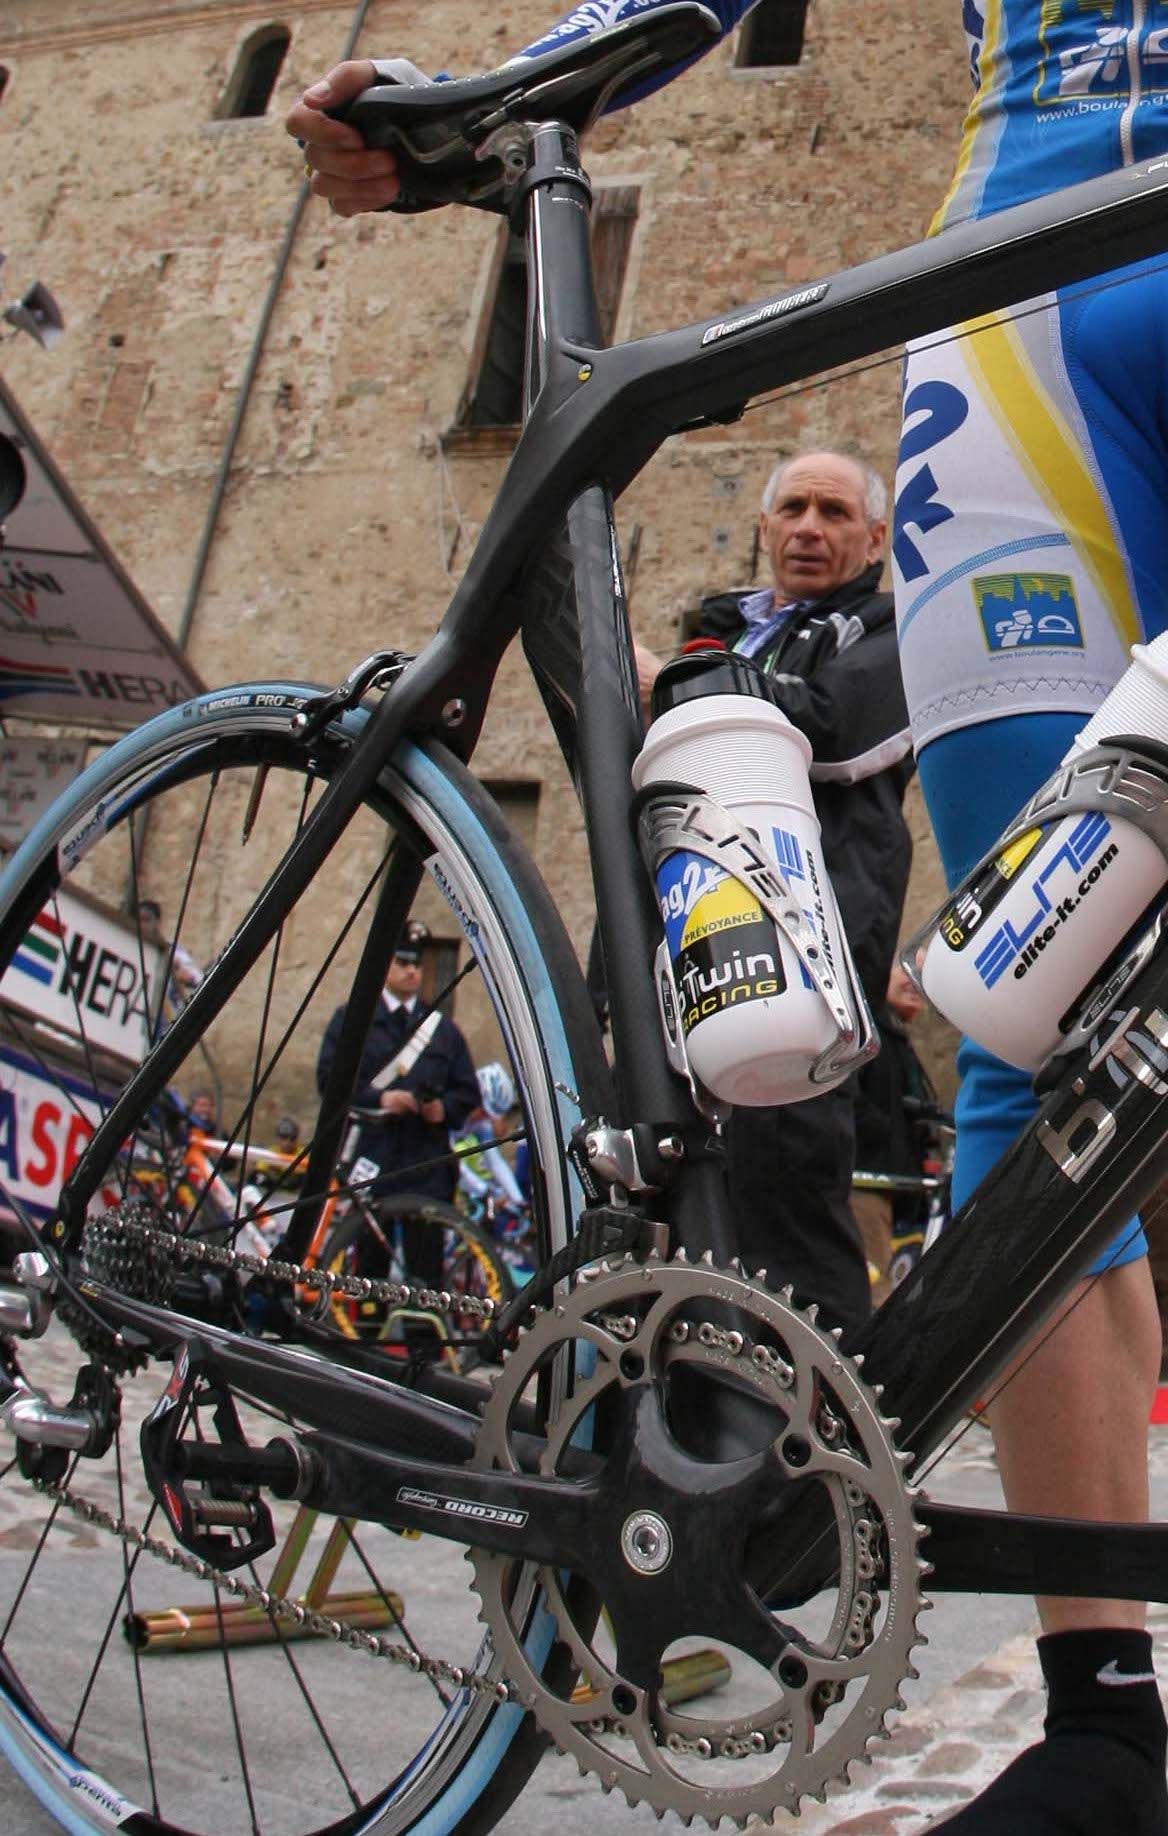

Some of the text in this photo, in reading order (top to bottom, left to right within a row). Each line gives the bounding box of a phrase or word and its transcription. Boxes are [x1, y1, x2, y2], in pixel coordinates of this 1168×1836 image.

[1012, 842, 1121, 981] elite-it.com
[59, 931, 151, 1030] HERA
[443, 1501, 524, 1525] RECORD
